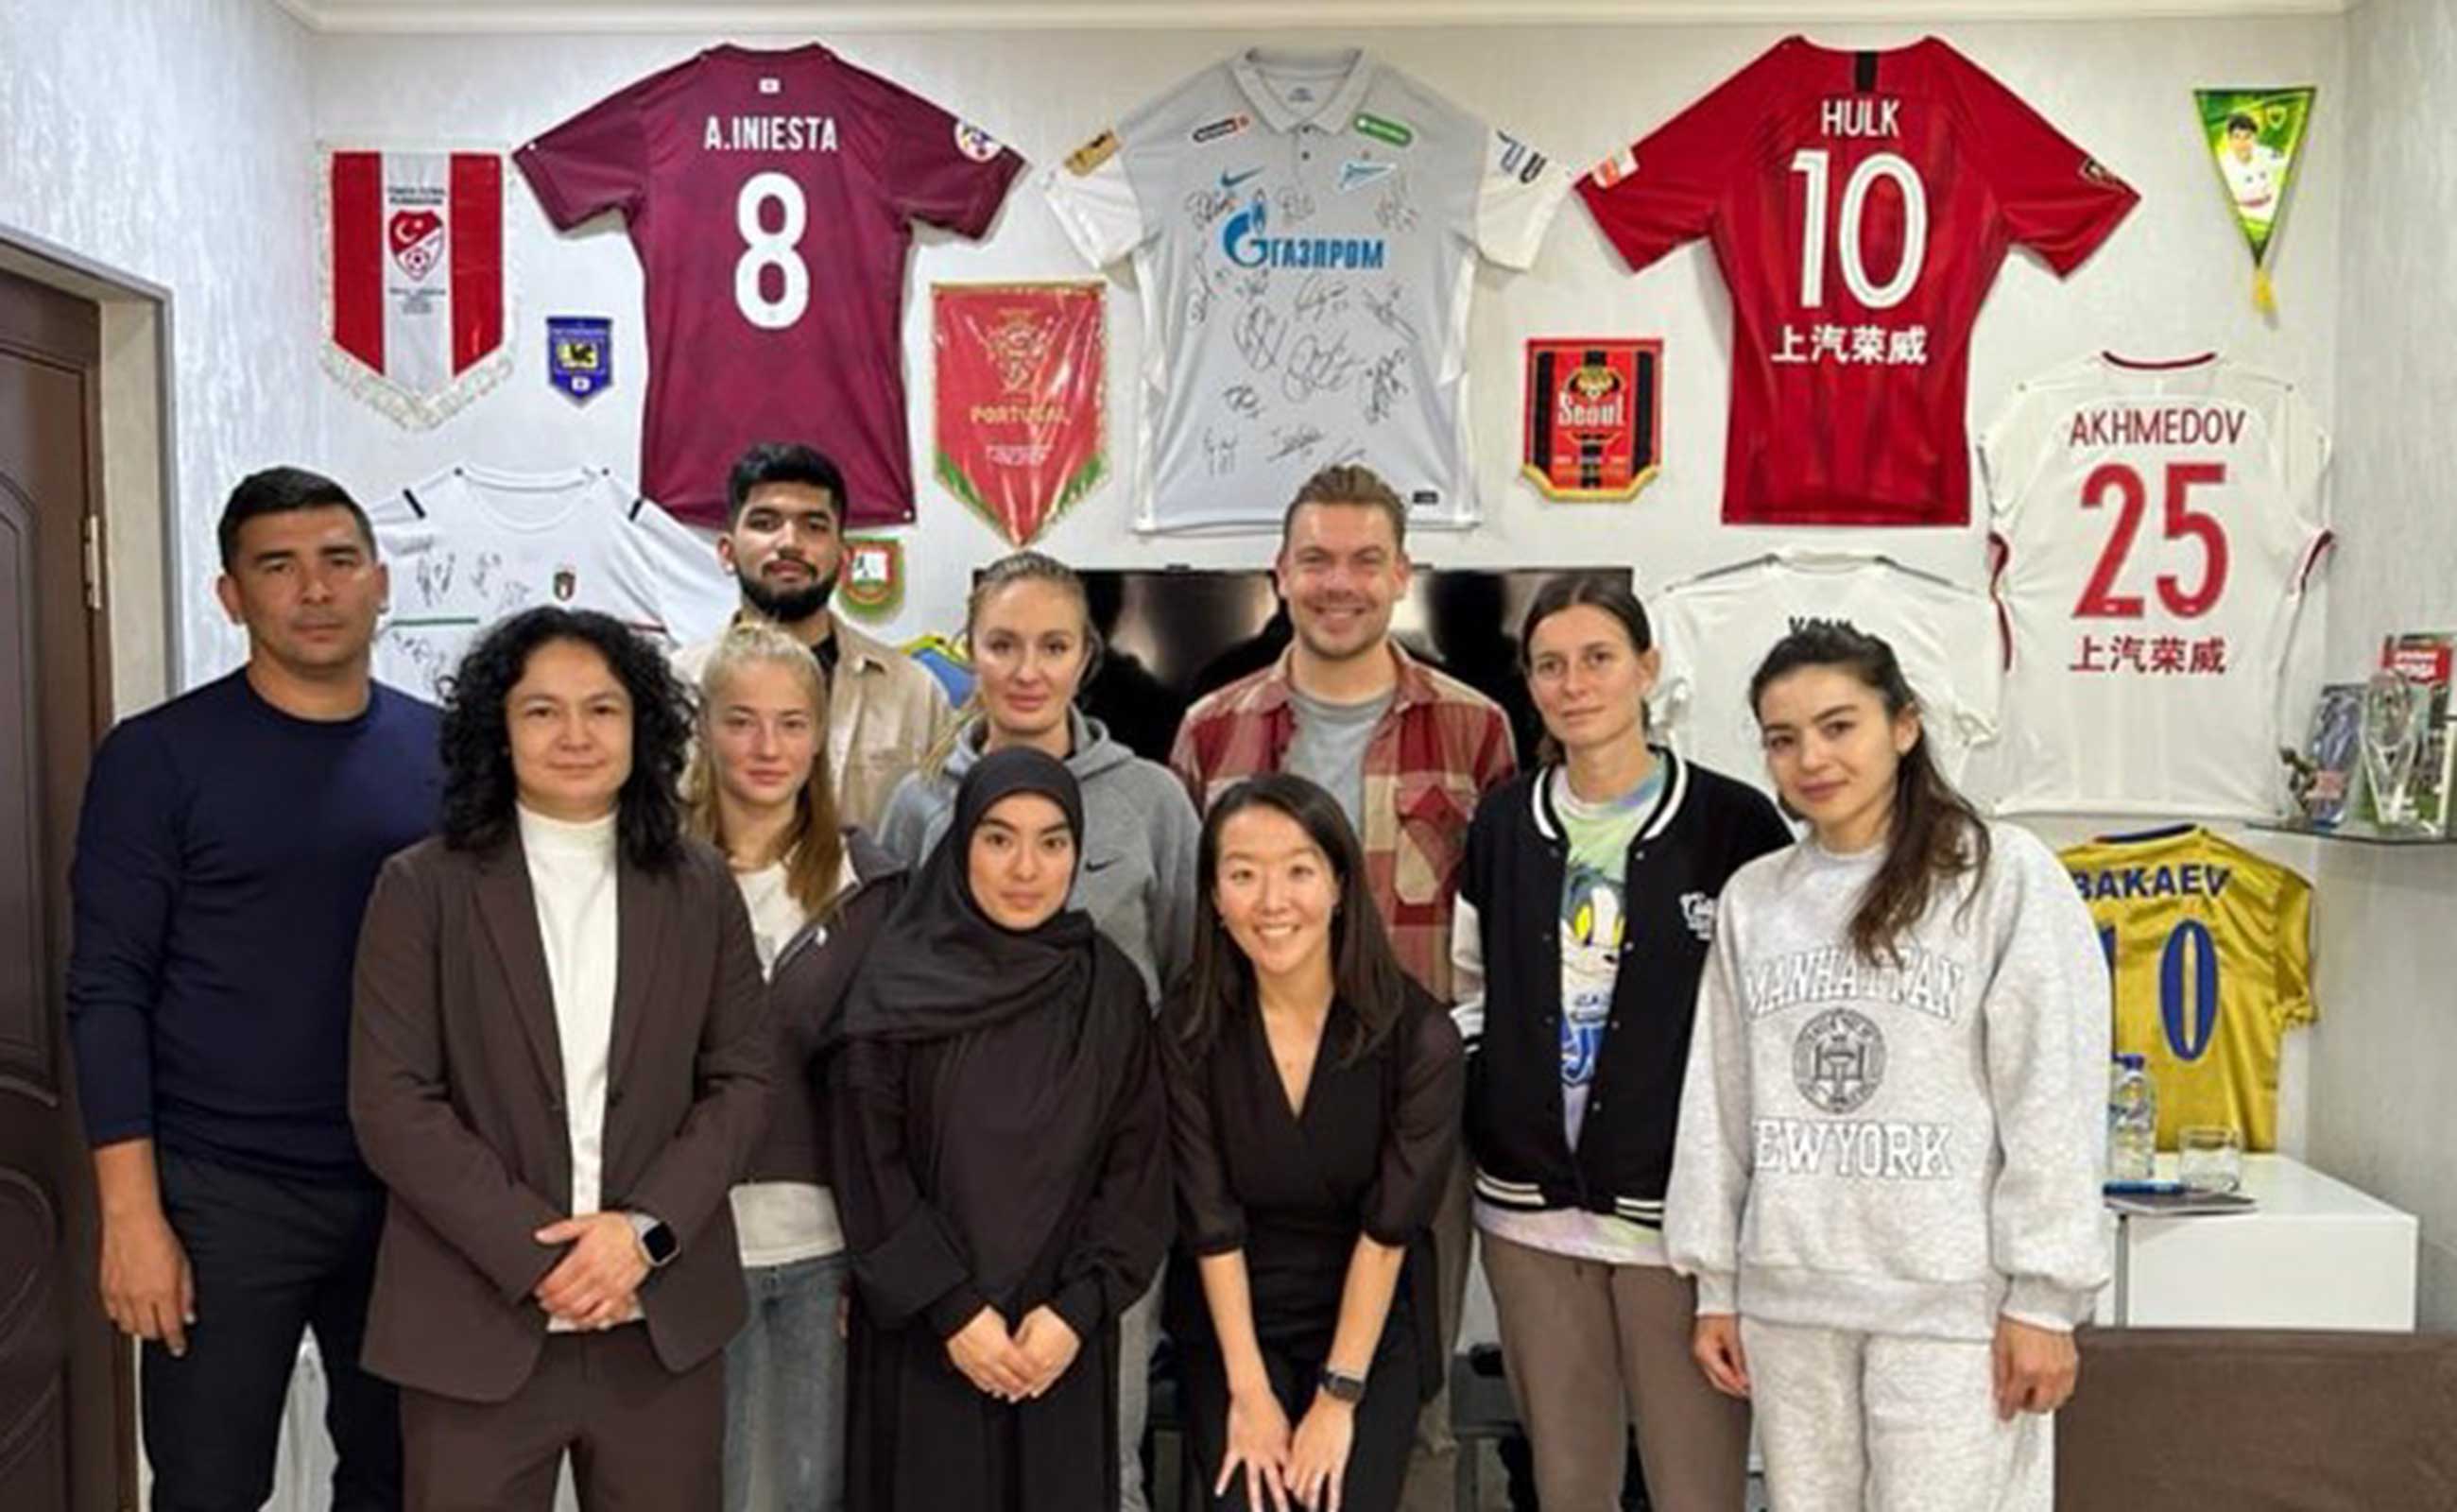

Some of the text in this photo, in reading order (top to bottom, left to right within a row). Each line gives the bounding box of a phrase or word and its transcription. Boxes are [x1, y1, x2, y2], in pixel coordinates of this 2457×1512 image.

[703, 115, 839, 151] A.INIESTA
[1820, 99, 1900, 137] HULK
[1790, 148, 1929, 309] 10
[734, 171, 810, 329] 8
[1270, 239, 1385, 269] ГАЗПРОМ
[1770, 324, 1928, 364] 上汽荣威
[1557, 390, 1624, 426] Seoul
[2069, 408, 2246, 447] AKHMEDOV
[2071, 462, 2229, 619] 25
[2068, 635, 2226, 675] 上汽荣威
[1744, 946, 1964, 1022] MANHAAN
[1834, 1121, 1954, 1178] YORK
